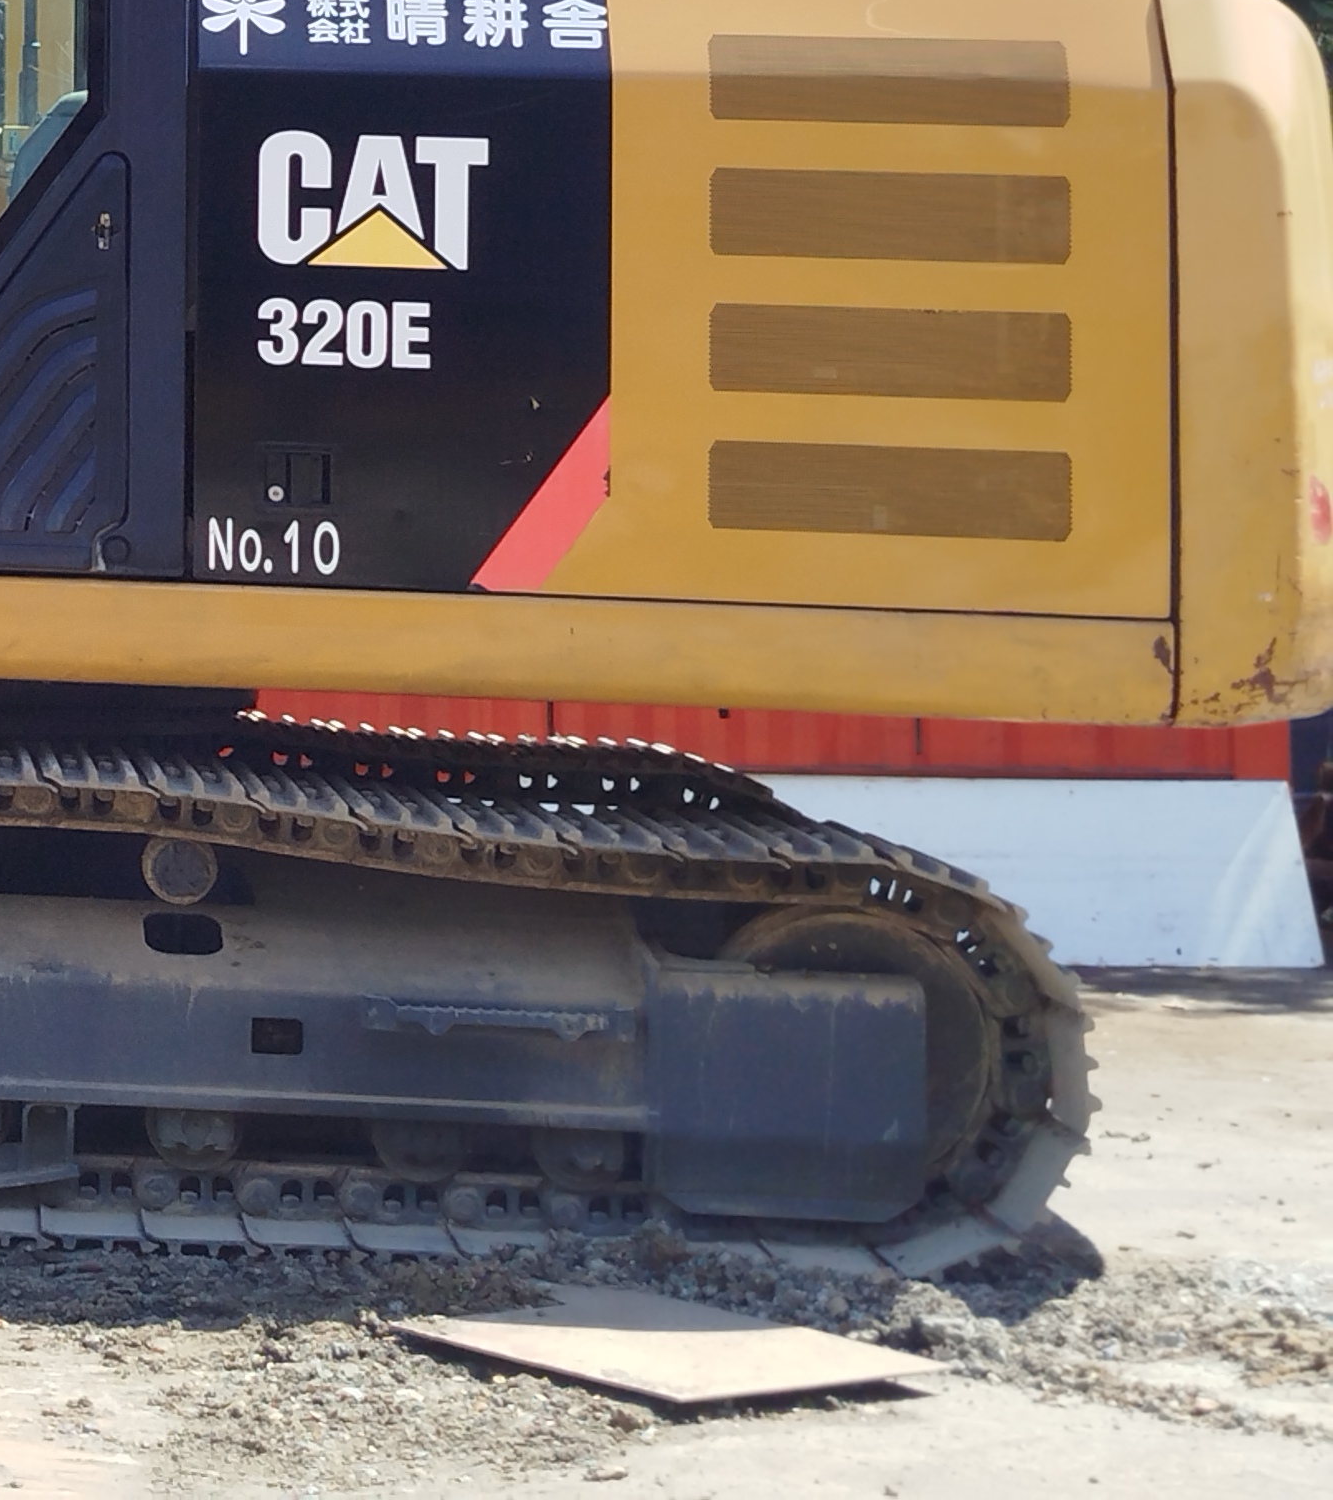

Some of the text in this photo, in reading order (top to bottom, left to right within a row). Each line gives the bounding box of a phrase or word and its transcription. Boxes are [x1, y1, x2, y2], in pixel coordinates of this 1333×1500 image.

[307, 18, 371, 44] 会社
[257, 130, 489, 271] CAT
[257, 298, 431, 368] 320E
[208, 516, 341, 576] No.10
